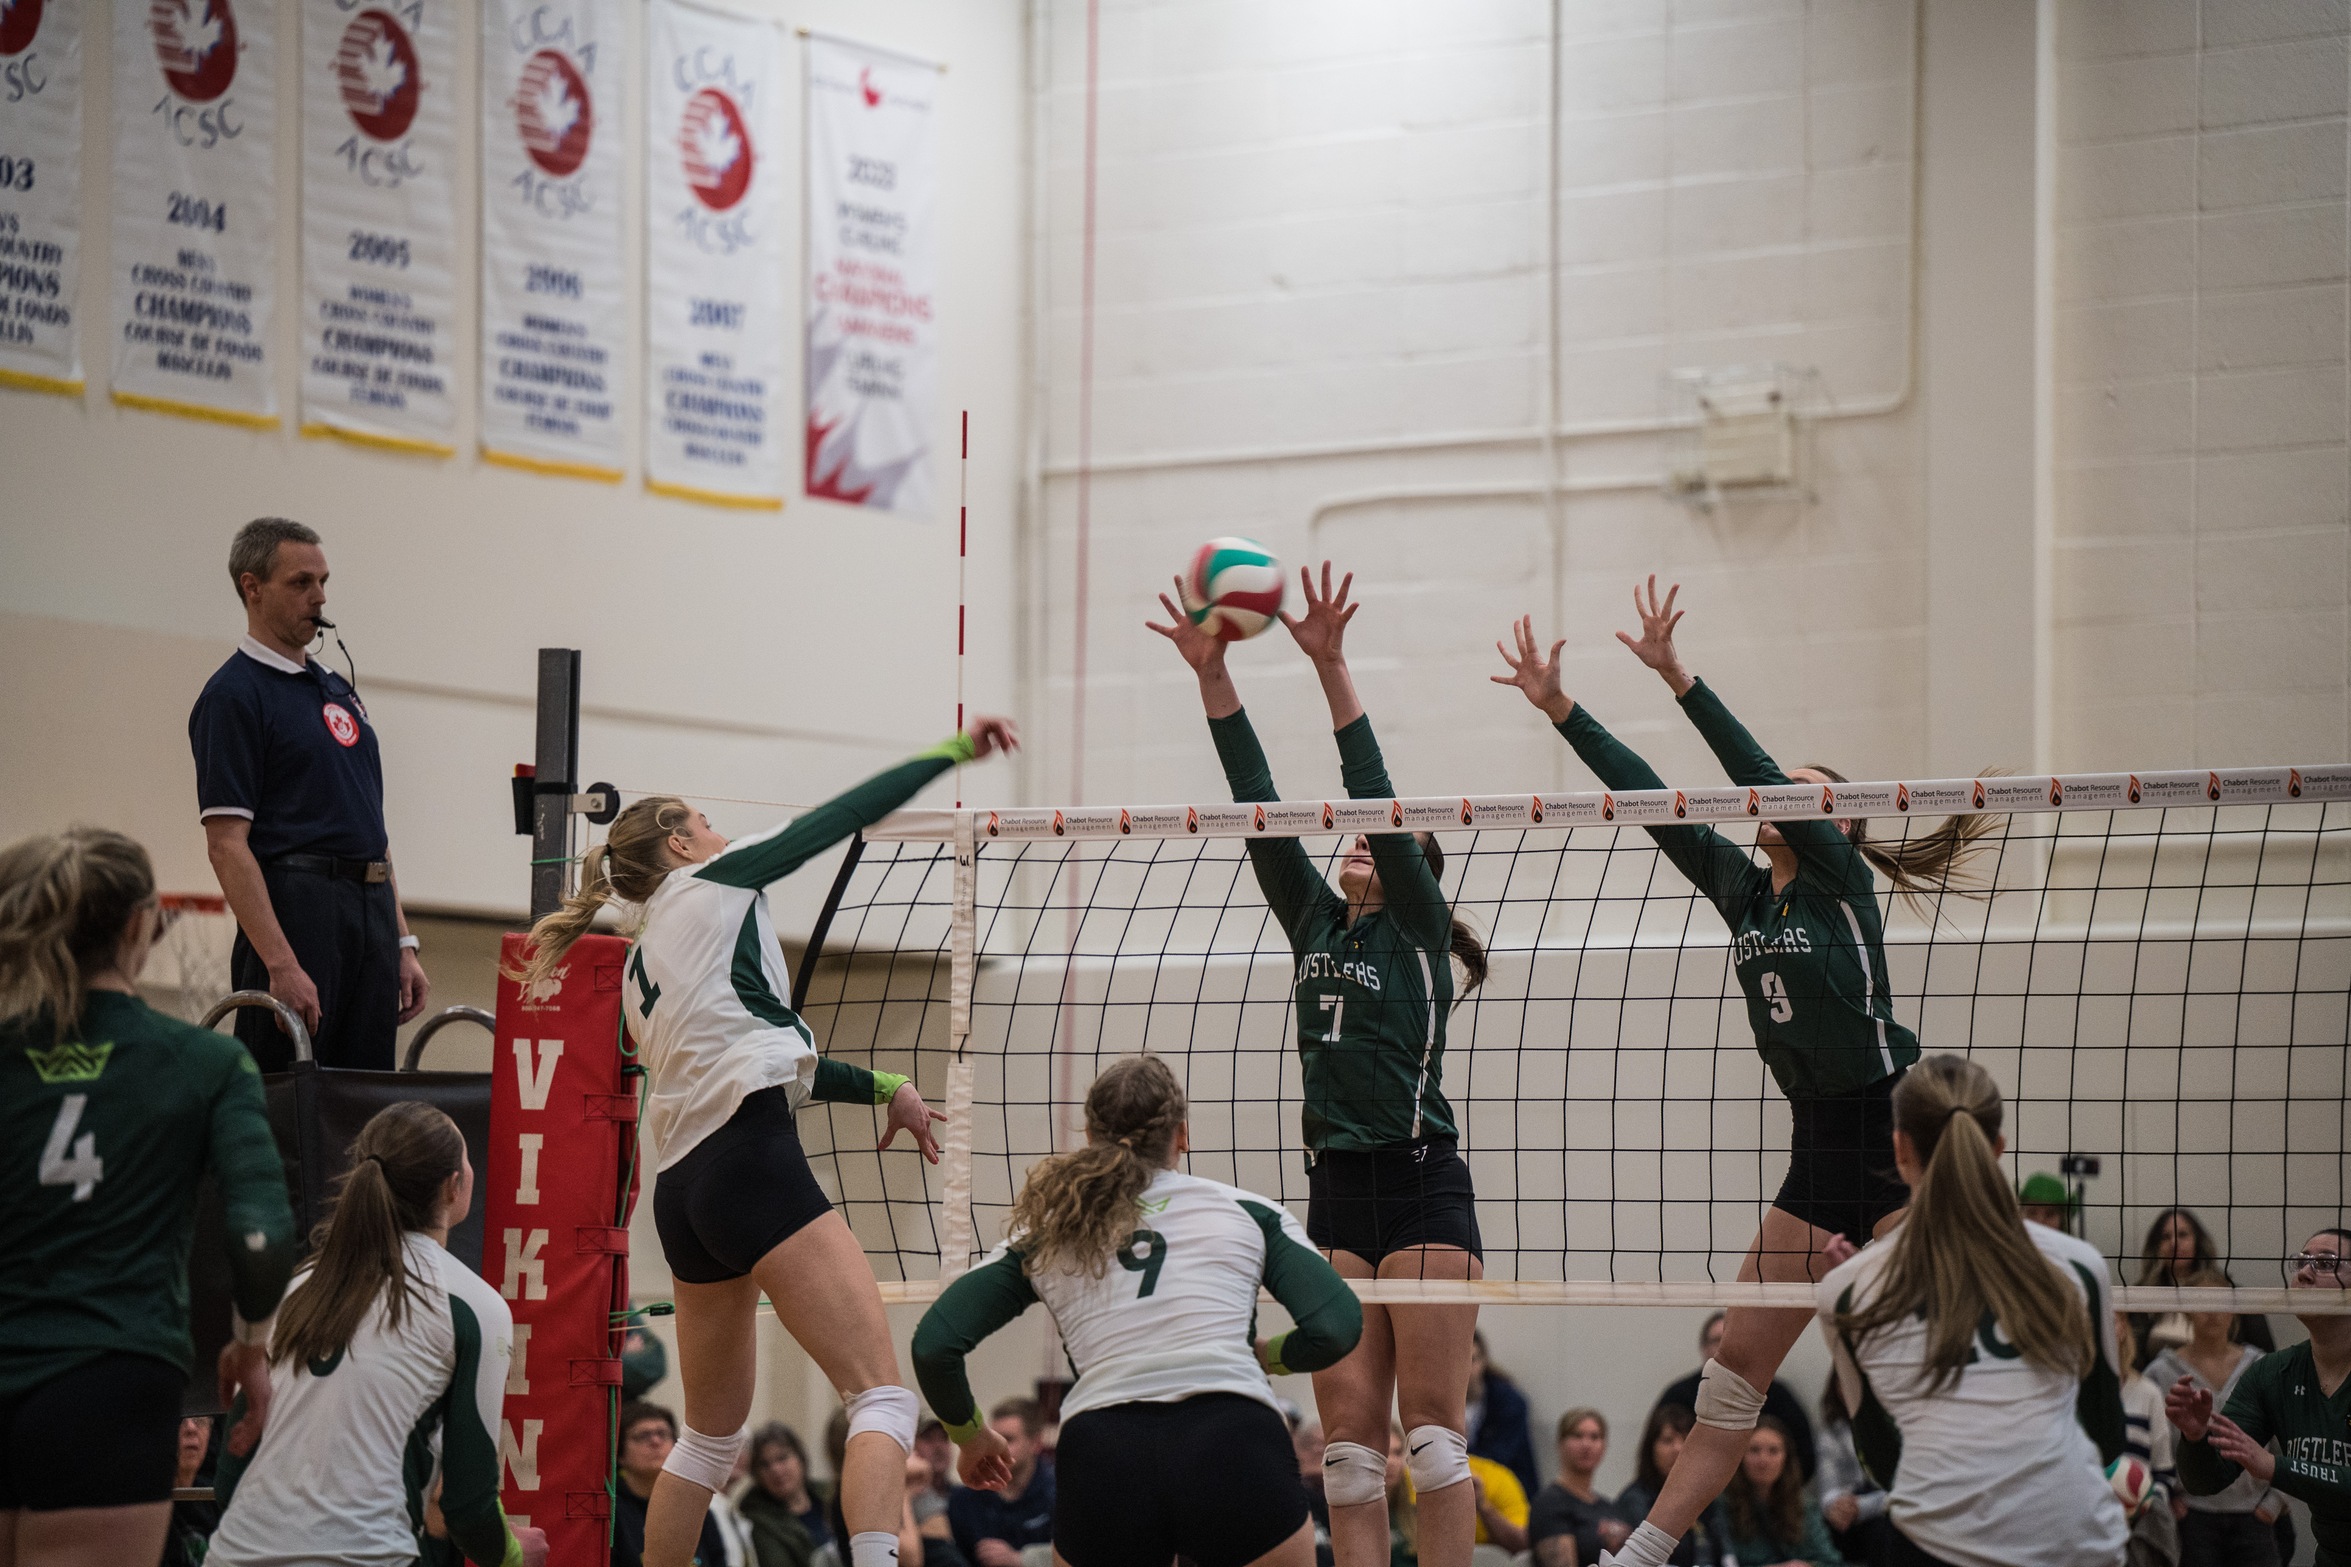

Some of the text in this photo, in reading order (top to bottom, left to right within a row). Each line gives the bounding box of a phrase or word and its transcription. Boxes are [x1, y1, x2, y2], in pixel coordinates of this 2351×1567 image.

[1688, 797, 1712, 805] Chabot
[1987, 787, 2011, 795] Chabot
[1065, 816, 1087, 824] Chabot
[1199, 813, 1221, 821] Chabot
[628, 944, 662, 1020] 1
[1760, 971, 1794, 1024] 9
[1319, 994, 1344, 1042] 7
[38, 1093, 104, 1201] 4
[498, 1037, 564, 1528] VIKIN
[1116, 1229, 1168, 1299] 9
[2290, 1460, 2339, 1484] TRUST
